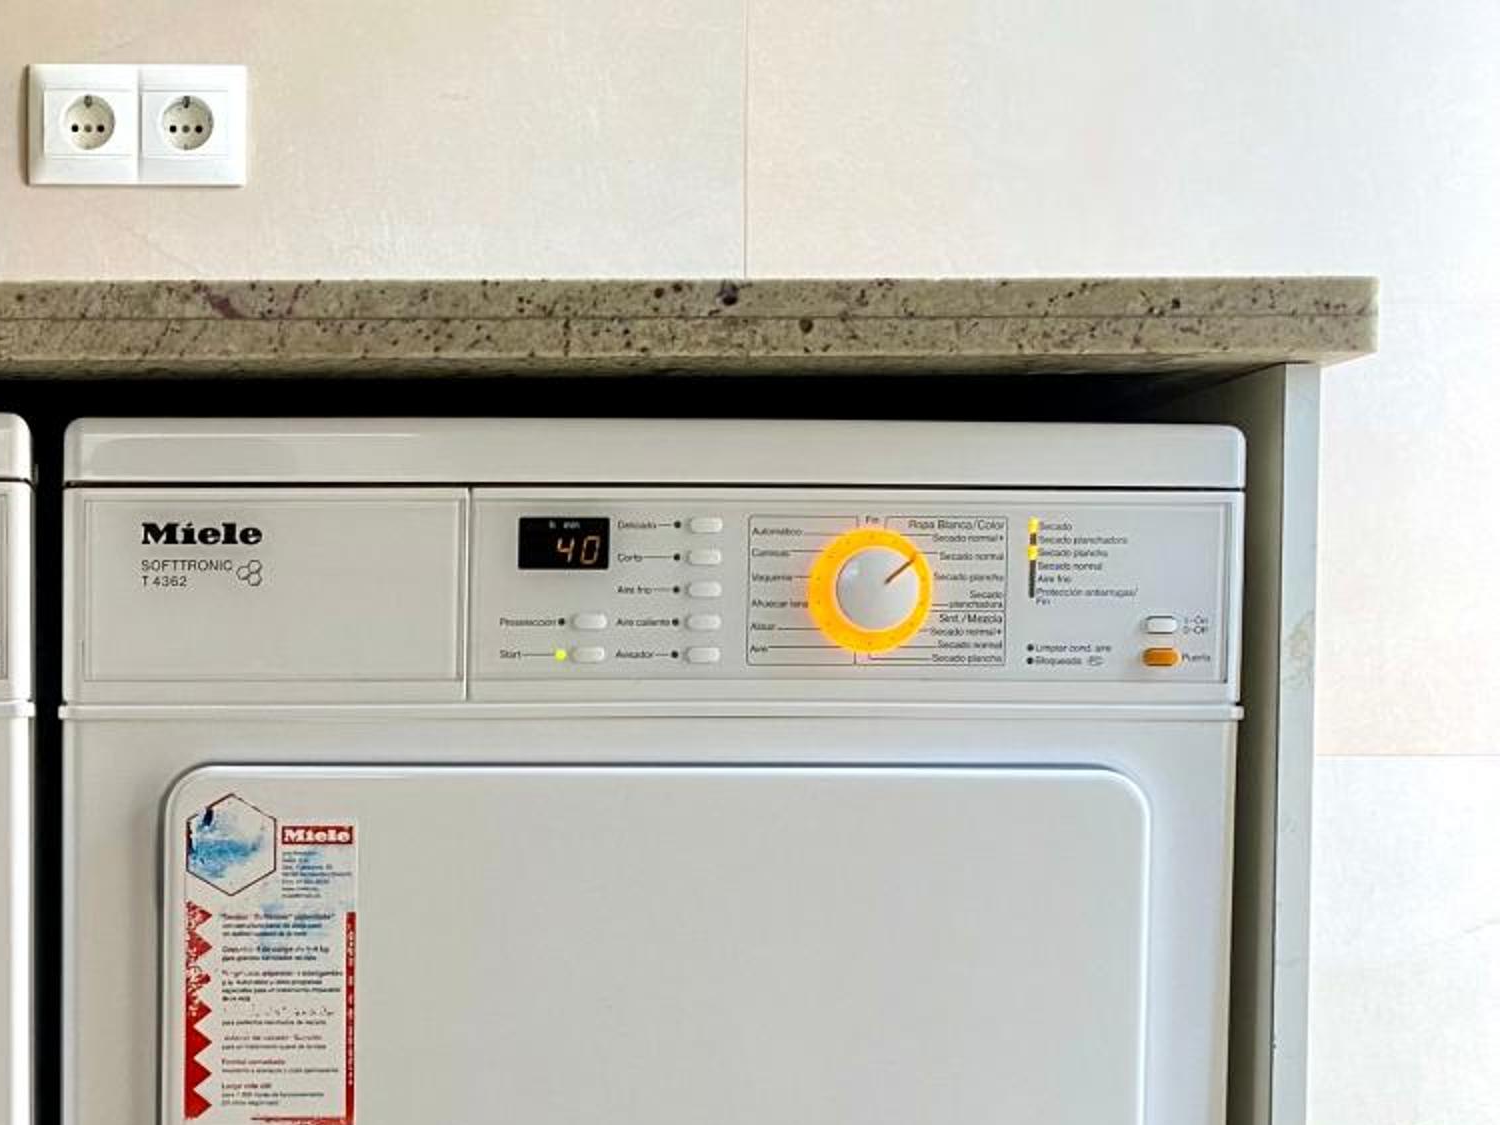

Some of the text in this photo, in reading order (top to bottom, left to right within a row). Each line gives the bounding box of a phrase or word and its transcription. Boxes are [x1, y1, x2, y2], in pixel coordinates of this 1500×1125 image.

[908, 518, 1004, 531] Ropa Blanca/Color
[141, 522, 263, 545] Miele
[932, 532, 966, 542] Secado
[557, 535, 601, 565] 40
[617, 552, 643, 563] Corto
[940, 551, 1004, 560] Secado normal
[141, 560, 232, 571] SOFTTRONIC
[142, 576, 187, 587] T 4362
[970, 590, 1002, 599] Secado
[932, 626, 965, 636] Secado
[500, 650, 521, 660] Start
[615, 650, 654, 660] Avisador
[932, 653, 965, 663] Secado
[283, 828, 351, 843] Miele
